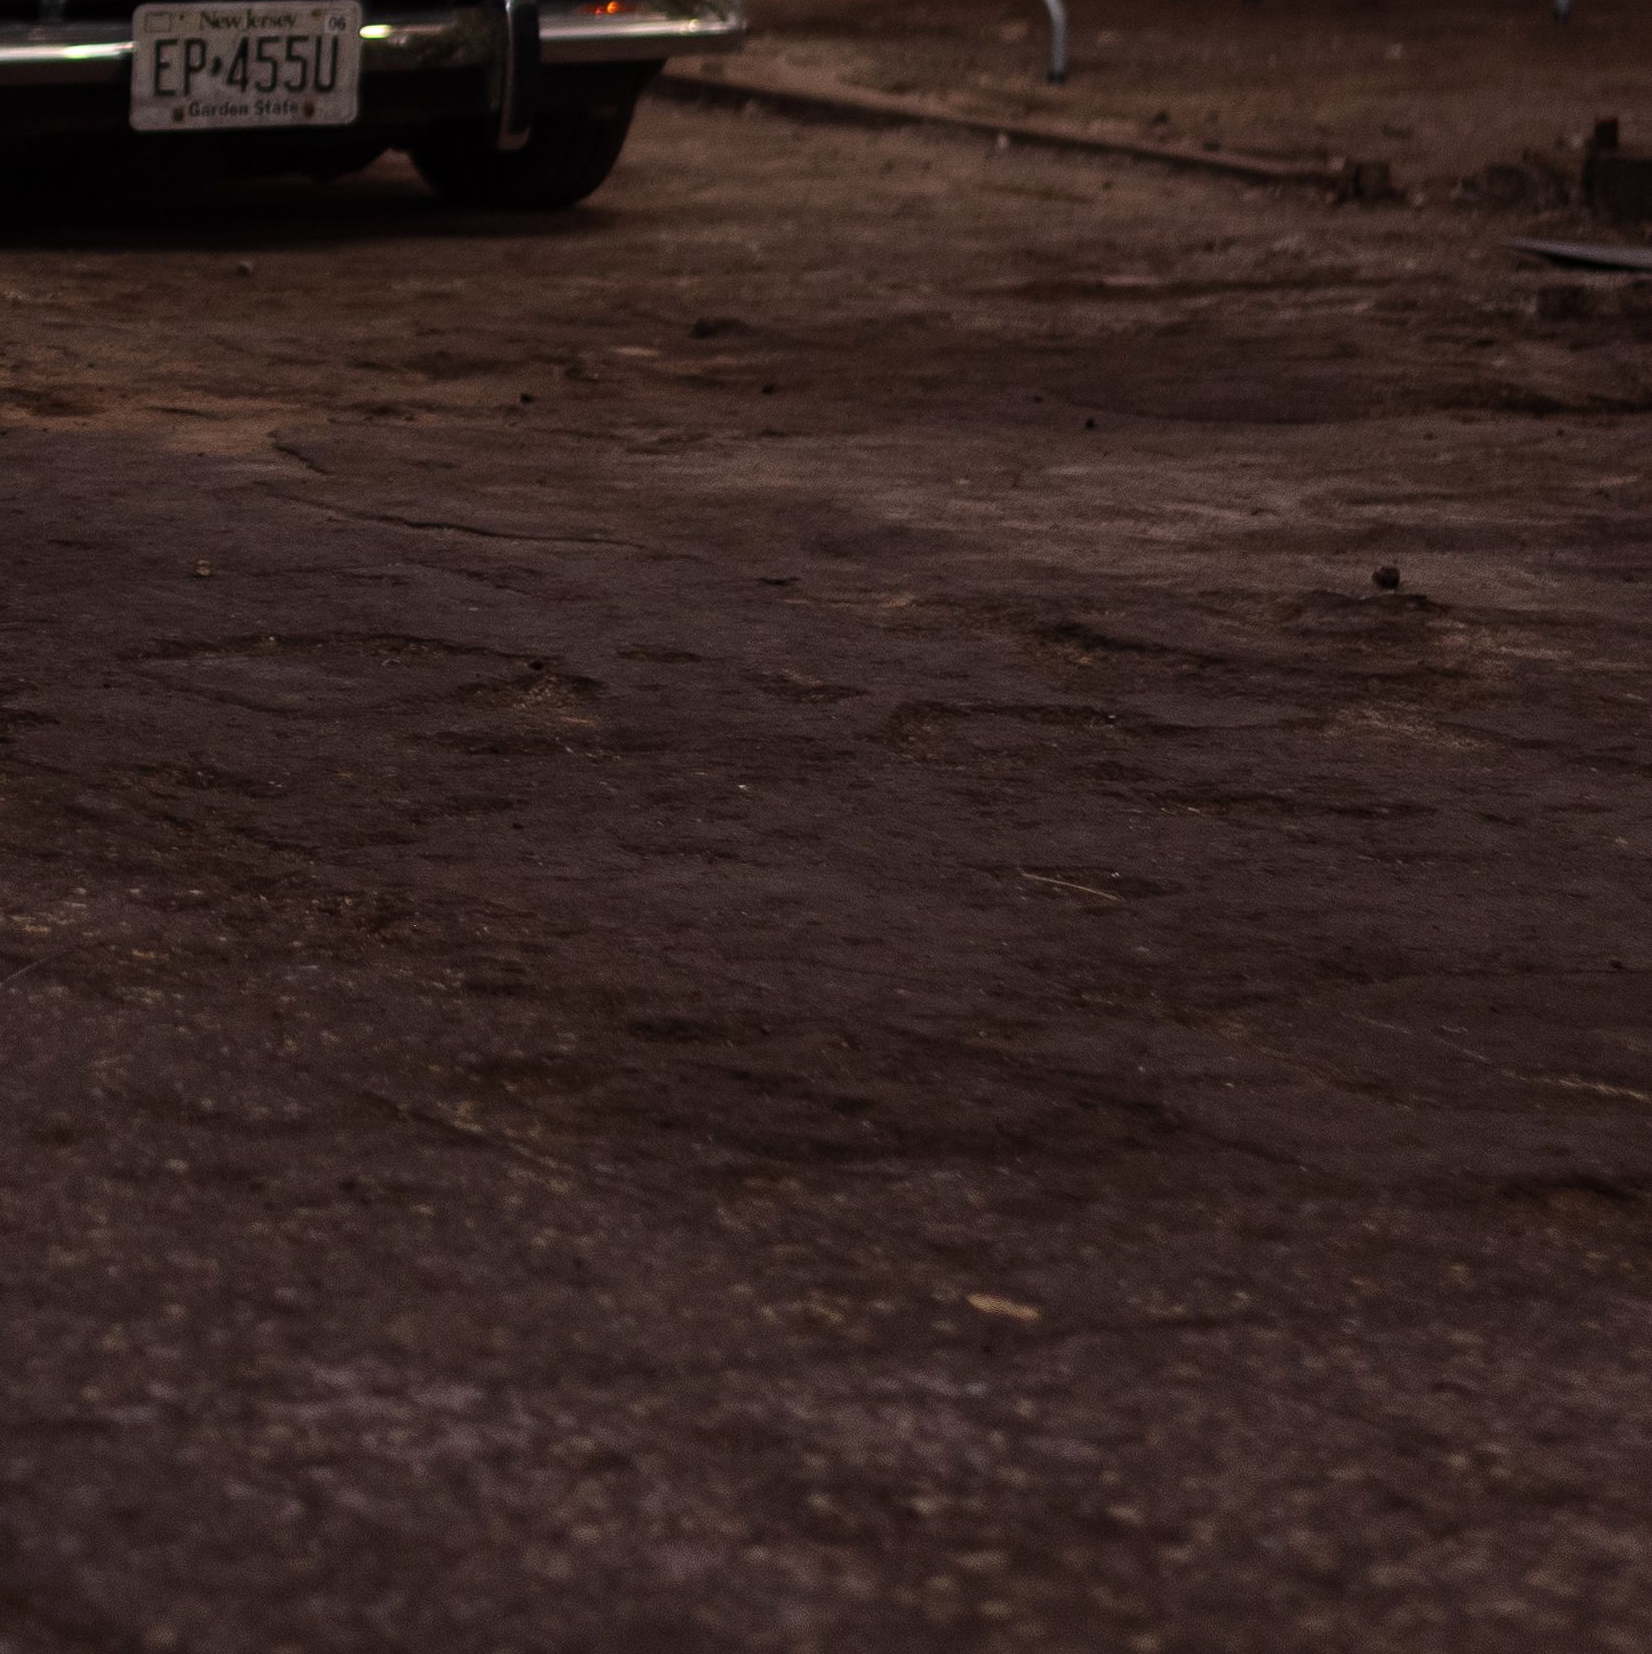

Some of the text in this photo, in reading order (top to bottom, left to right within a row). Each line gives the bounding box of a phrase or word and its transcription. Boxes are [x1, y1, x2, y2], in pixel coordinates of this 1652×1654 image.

[199, 8, 298, 31] New Jersey
[187, 98, 299, 118] Garden State
